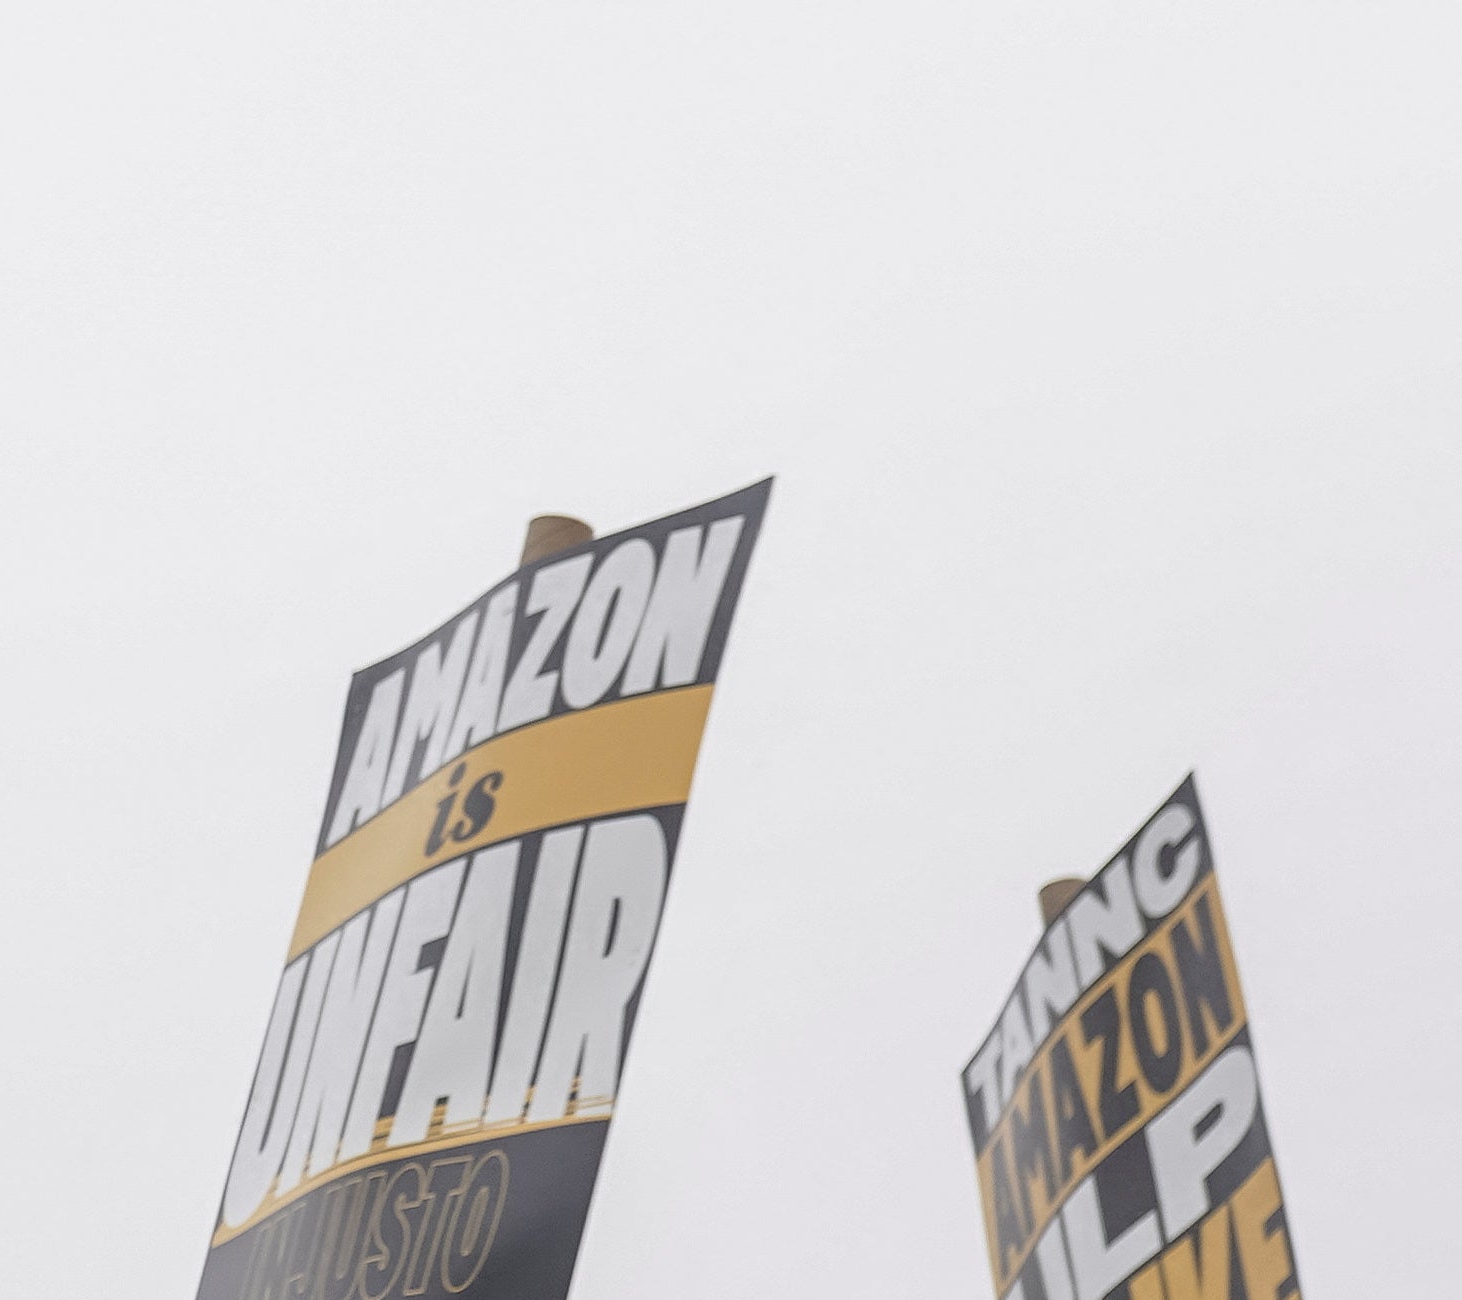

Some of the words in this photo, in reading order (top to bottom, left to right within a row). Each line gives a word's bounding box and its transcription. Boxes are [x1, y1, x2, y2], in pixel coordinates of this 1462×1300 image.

[326, 514, 748, 849] AMAZON
[423, 763, 504, 857] is
[220, 813, 670, 1234] UNFAIR
[968, 798, 1201, 1132] TANNC
[990, 891, 1237, 1278] AMAZON
